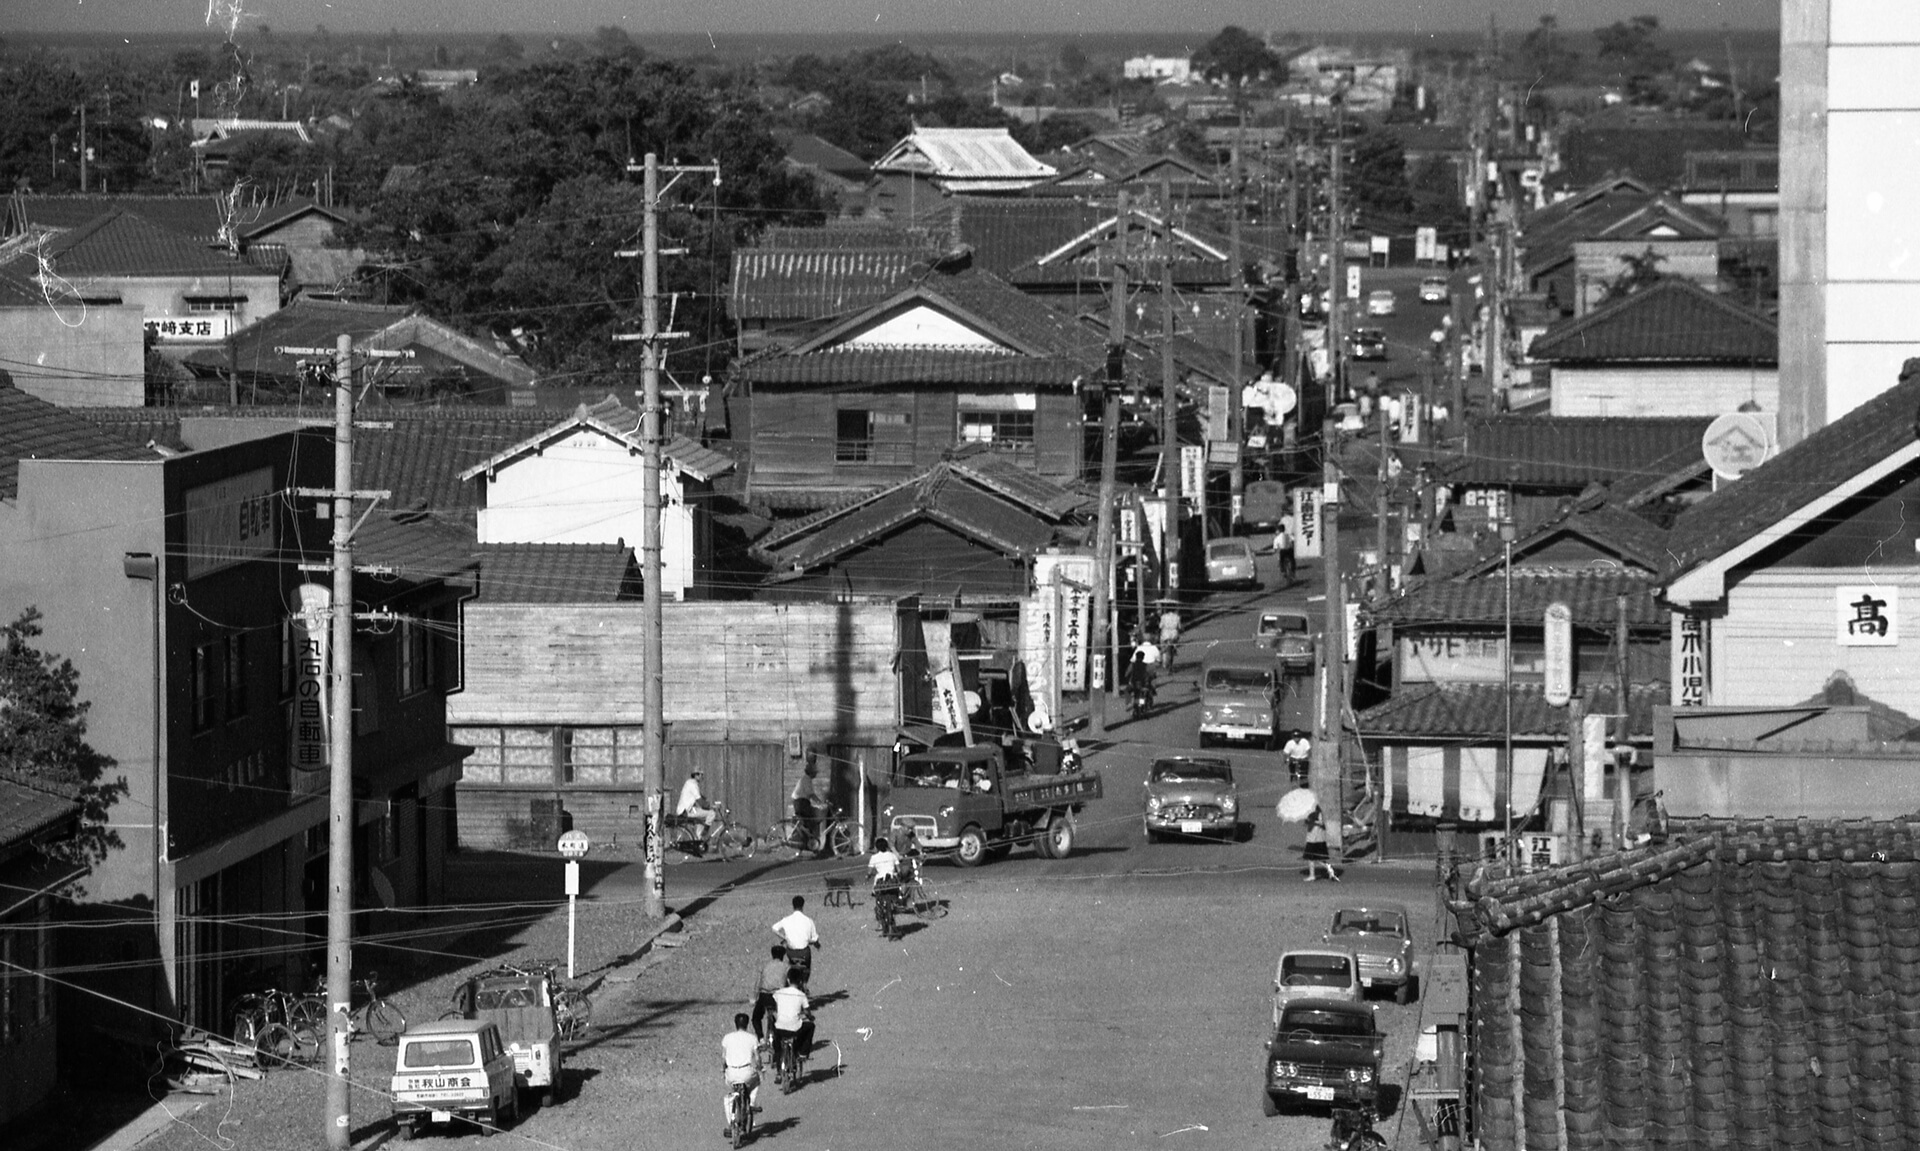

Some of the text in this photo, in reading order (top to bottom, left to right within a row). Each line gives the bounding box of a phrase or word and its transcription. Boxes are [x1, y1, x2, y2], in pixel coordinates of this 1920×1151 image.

[239, 490, 270, 541] 自転車
[1847, 594, 1889, 638] 高
[1682, 612, 1702, 706] 高木小児
[300, 638, 321, 763] 丸石の自転車
